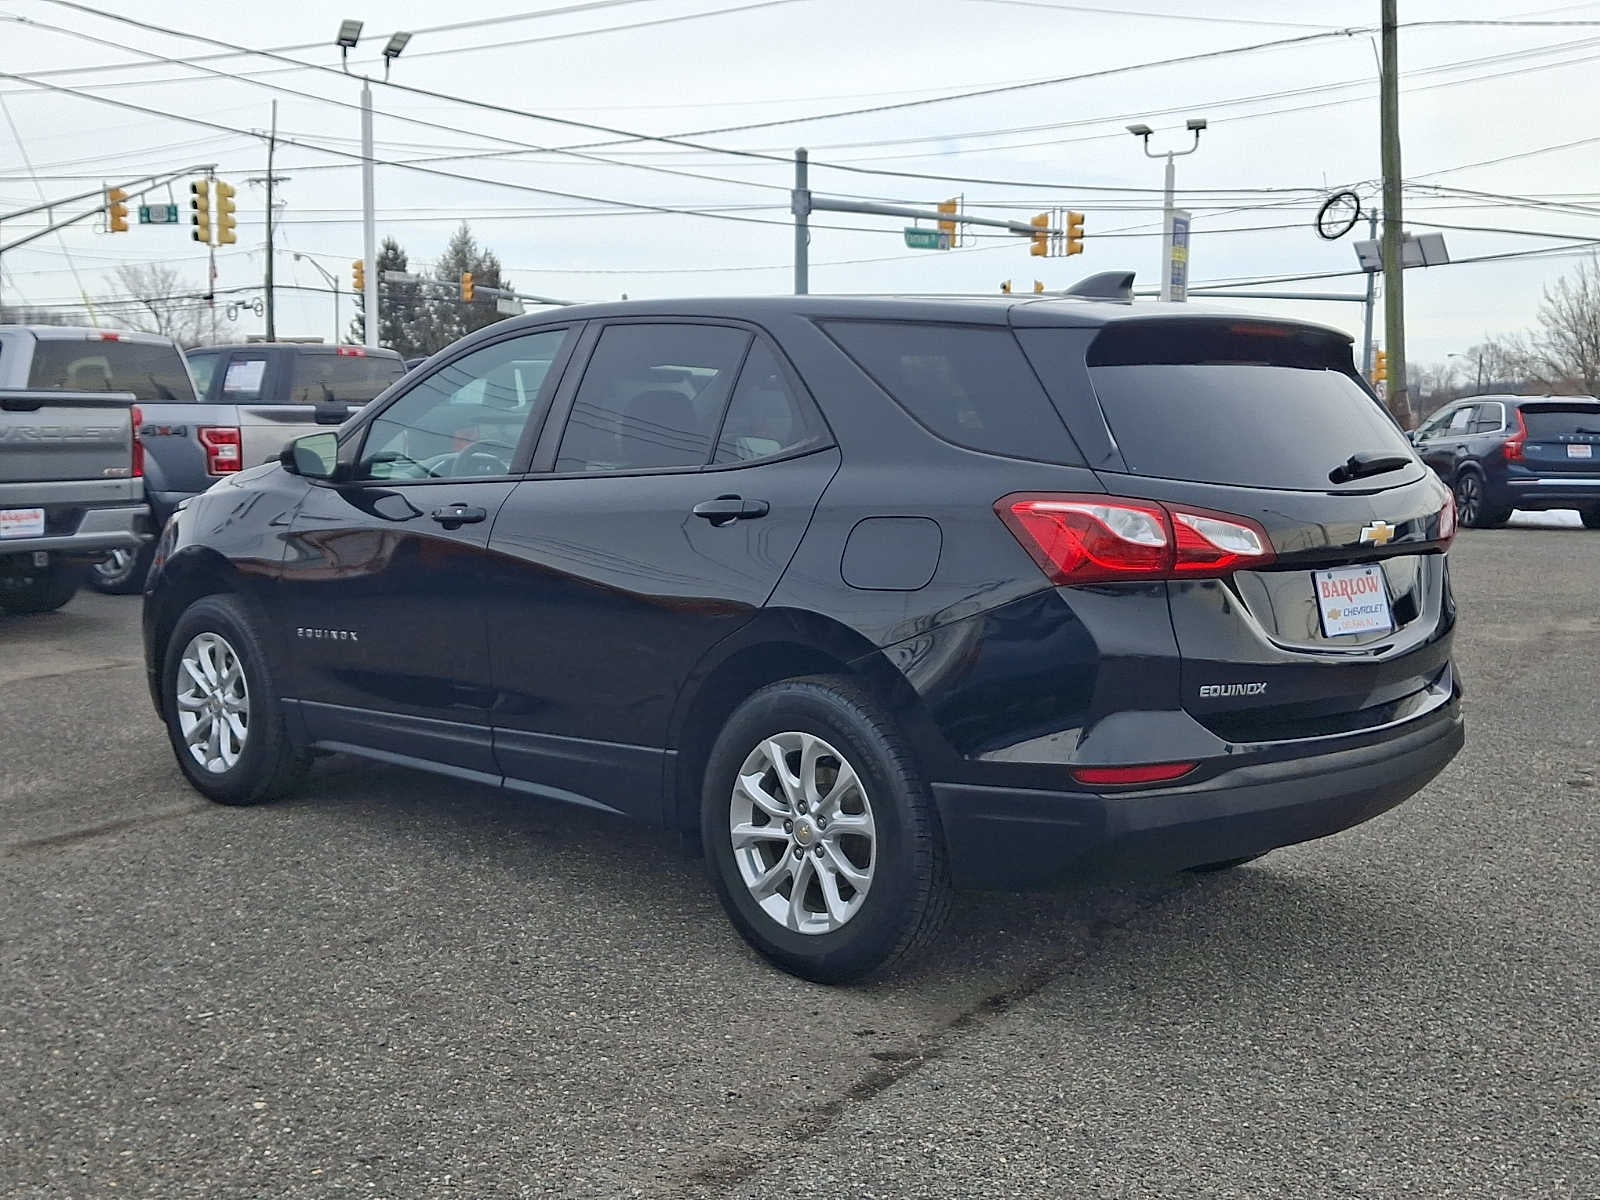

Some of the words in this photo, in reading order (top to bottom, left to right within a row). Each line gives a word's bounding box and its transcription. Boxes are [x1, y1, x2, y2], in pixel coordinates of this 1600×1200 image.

[1321, 576, 1379, 603] BARLOW
[1343, 604, 1383, 617] CHEVROLET
[297, 628, 358, 641] EQUINOX
[1199, 683, 1267, 697] EQUINOX
